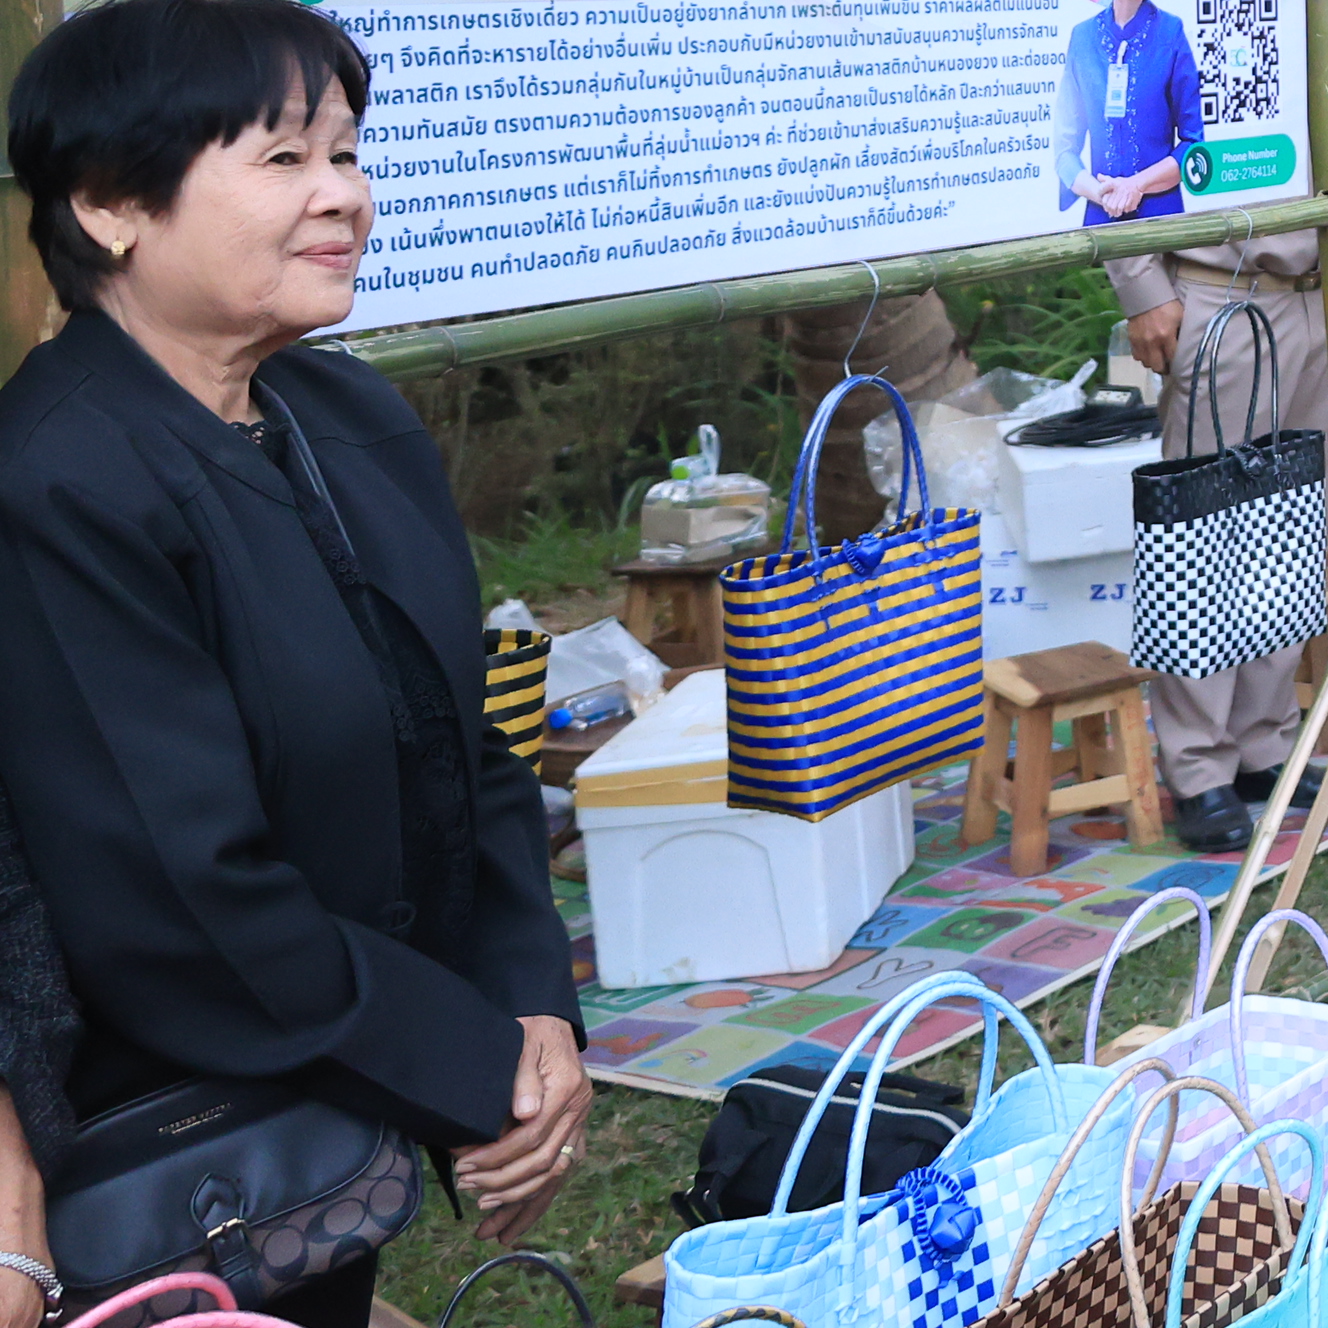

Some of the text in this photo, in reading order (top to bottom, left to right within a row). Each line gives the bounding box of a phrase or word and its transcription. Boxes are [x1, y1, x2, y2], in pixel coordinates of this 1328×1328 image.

[367, 82, 458, 106] พลาสติก
[1002, 48, 1067, 70] และต่อยอด
[356, 114, 488, 144] ความทันสมัย
[960, 80, 1056, 100] ปีละกว่าแสนบาท
[766, 125, 783, 145] ค่ะ
[1221, 165, 1277, 182] 062-2764114
[1222, 148, 1278, 163] Phone Number
[374, 182, 558, 217] นอกภาคการเกษตร
[564, 163, 773, 198] แต่เราก็ไม่ทิ้งการทำเกษตร
[777, 149, 852, 180] ยังปลูกผัก
[391, 209, 586, 252] เน้นพึ่งพาตนเองให้ได้
[591, 193, 739, 233] ไม่ก่อหนี้สินเพิ่มอีก
[471, 246, 601, 280] คนทำปลอดภัย
[606, 229, 727, 261] คนกินปลอดภัย
